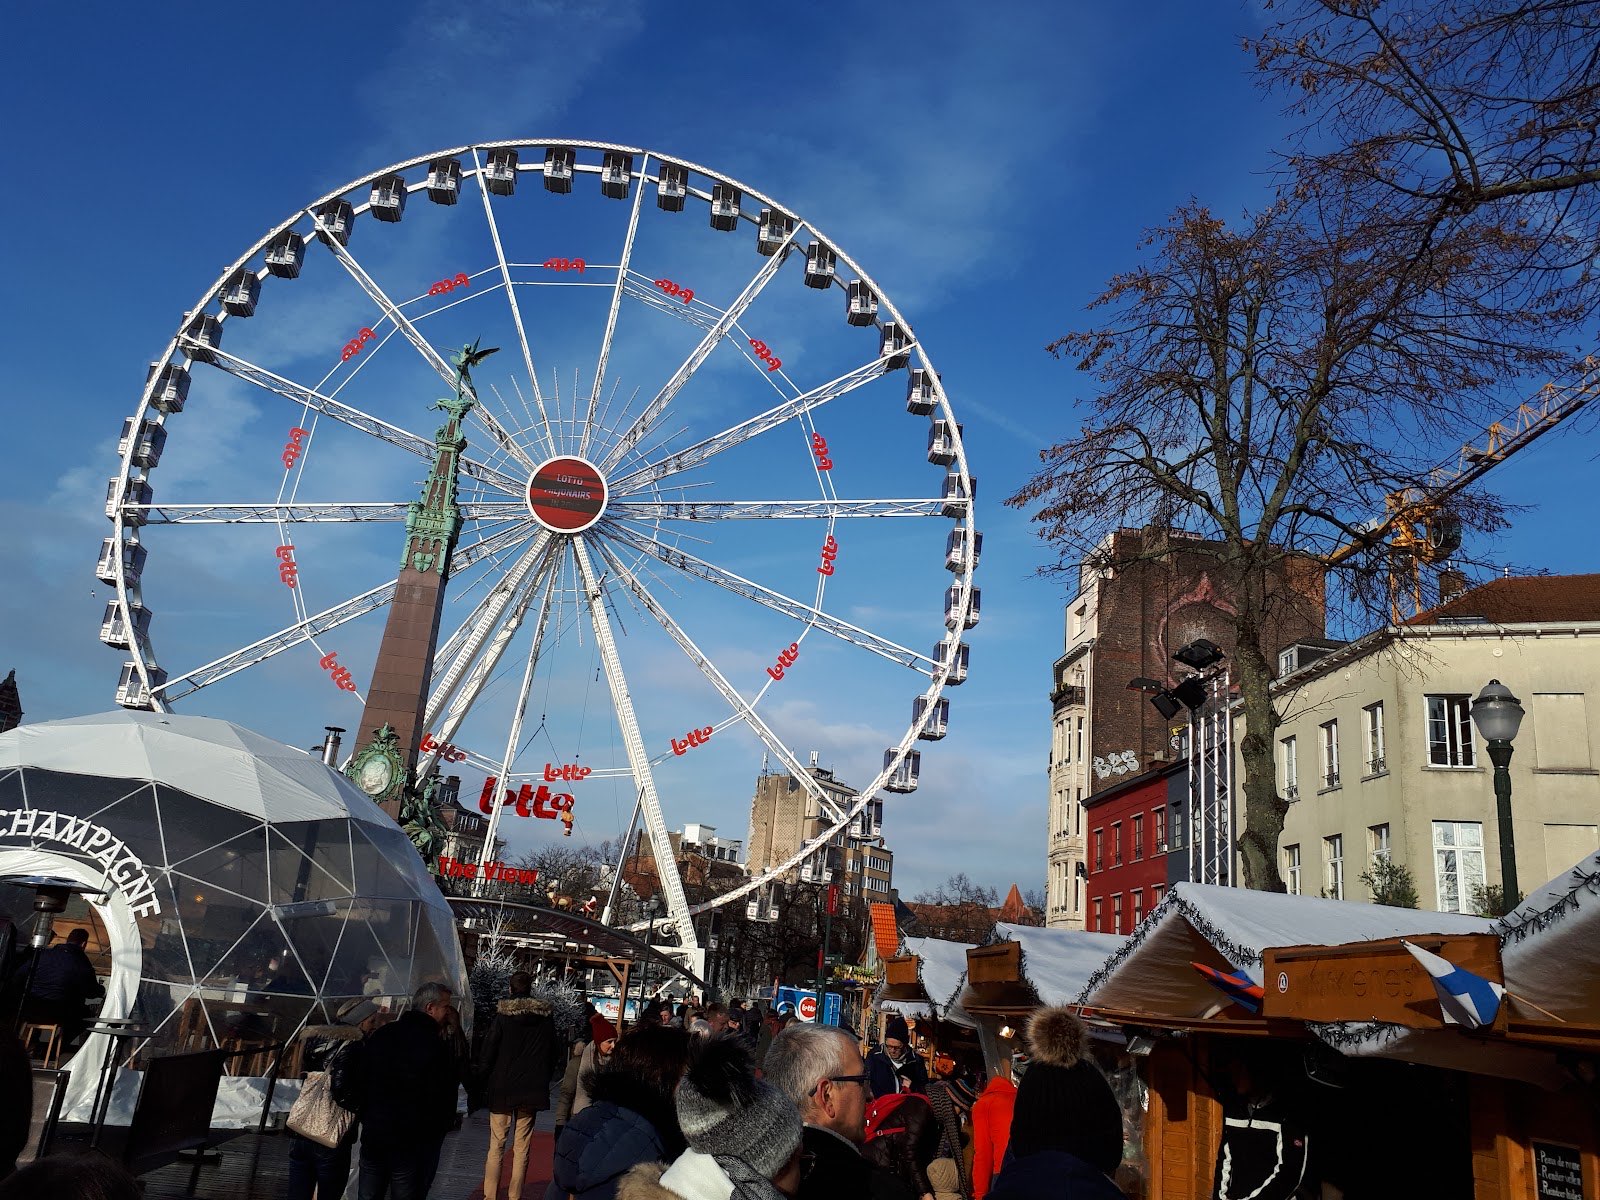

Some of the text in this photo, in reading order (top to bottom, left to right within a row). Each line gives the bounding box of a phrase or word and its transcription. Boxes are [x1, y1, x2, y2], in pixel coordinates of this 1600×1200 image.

[557, 473, 583, 486] LOTTO
[438, 855, 538, 885] The View
